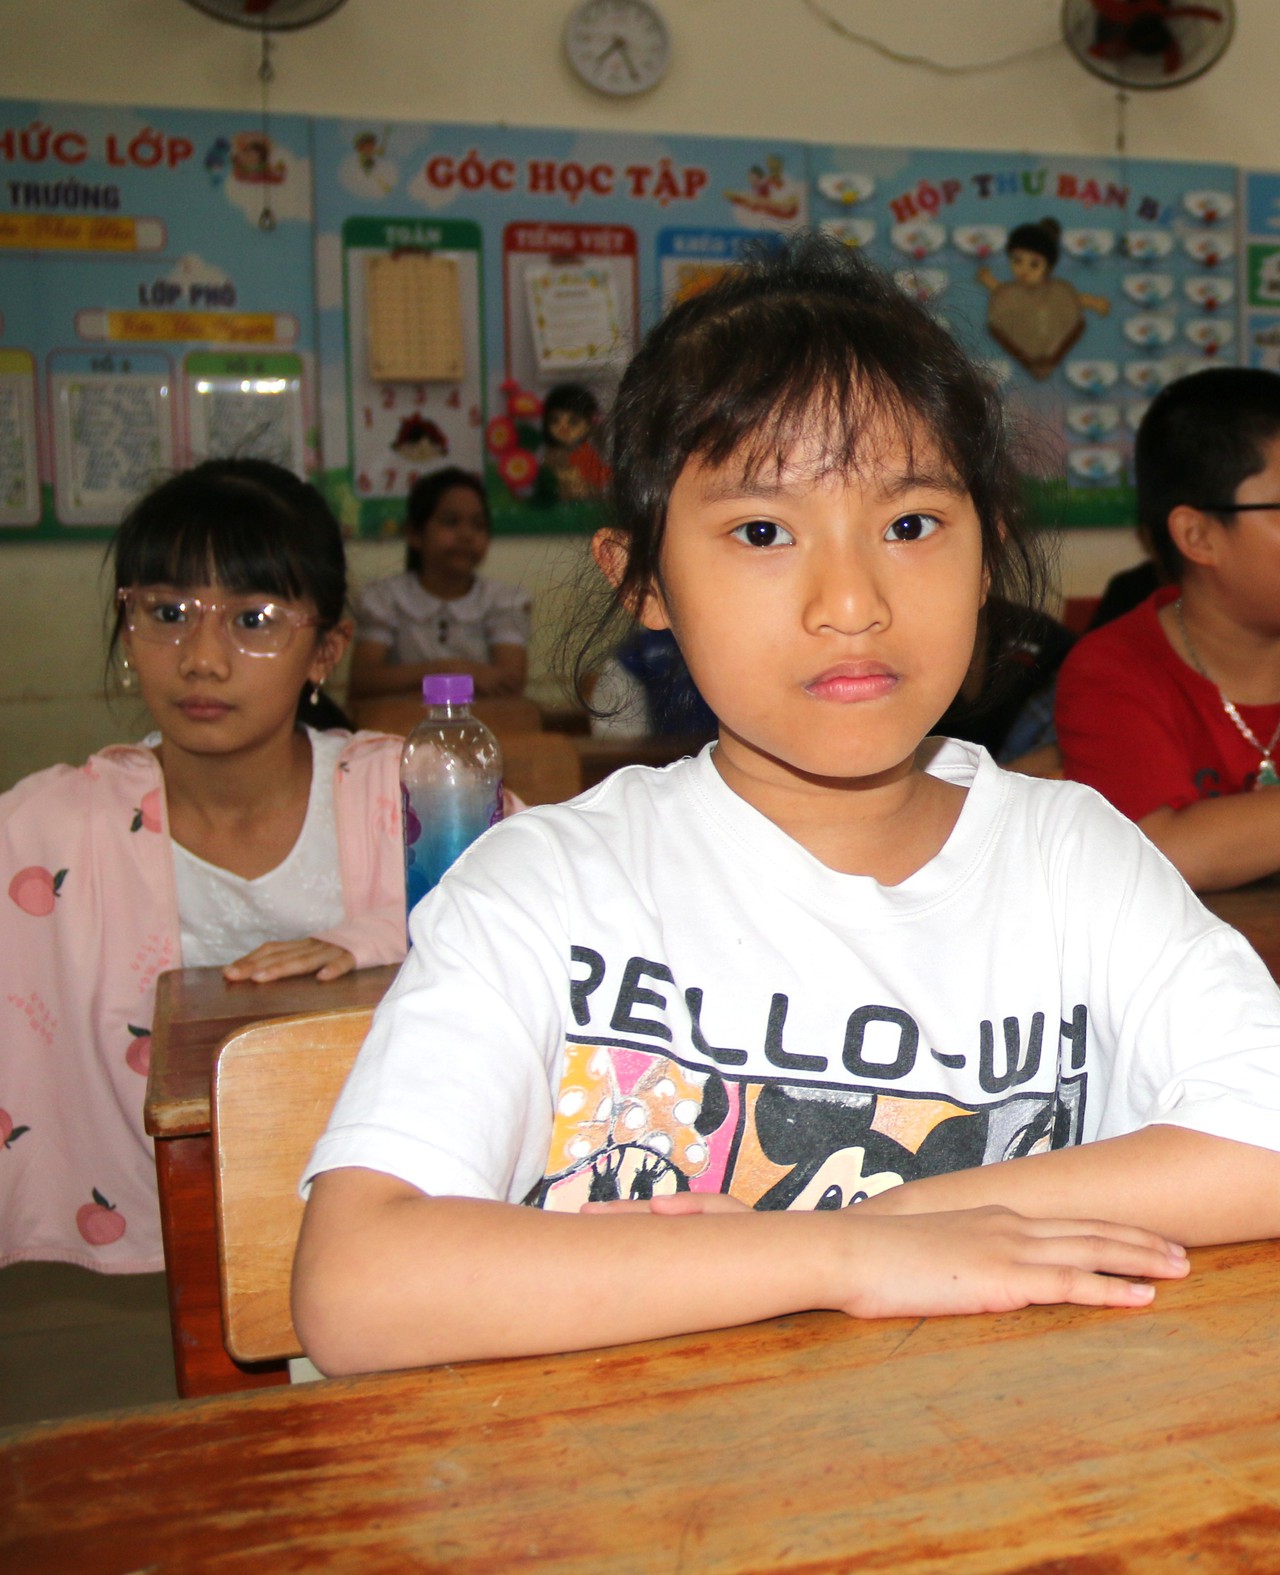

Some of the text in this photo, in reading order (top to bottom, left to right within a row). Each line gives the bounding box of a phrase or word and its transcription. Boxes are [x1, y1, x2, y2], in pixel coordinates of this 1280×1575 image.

[105, 127, 194, 170] LỚP
[427, 147, 707, 208] GÓC HỌC TẬP
[889, 178, 962, 224] HỘP
[1056, 171, 1131, 211] BẠN
[139, 278, 236, 308] LỚP PHÓ
